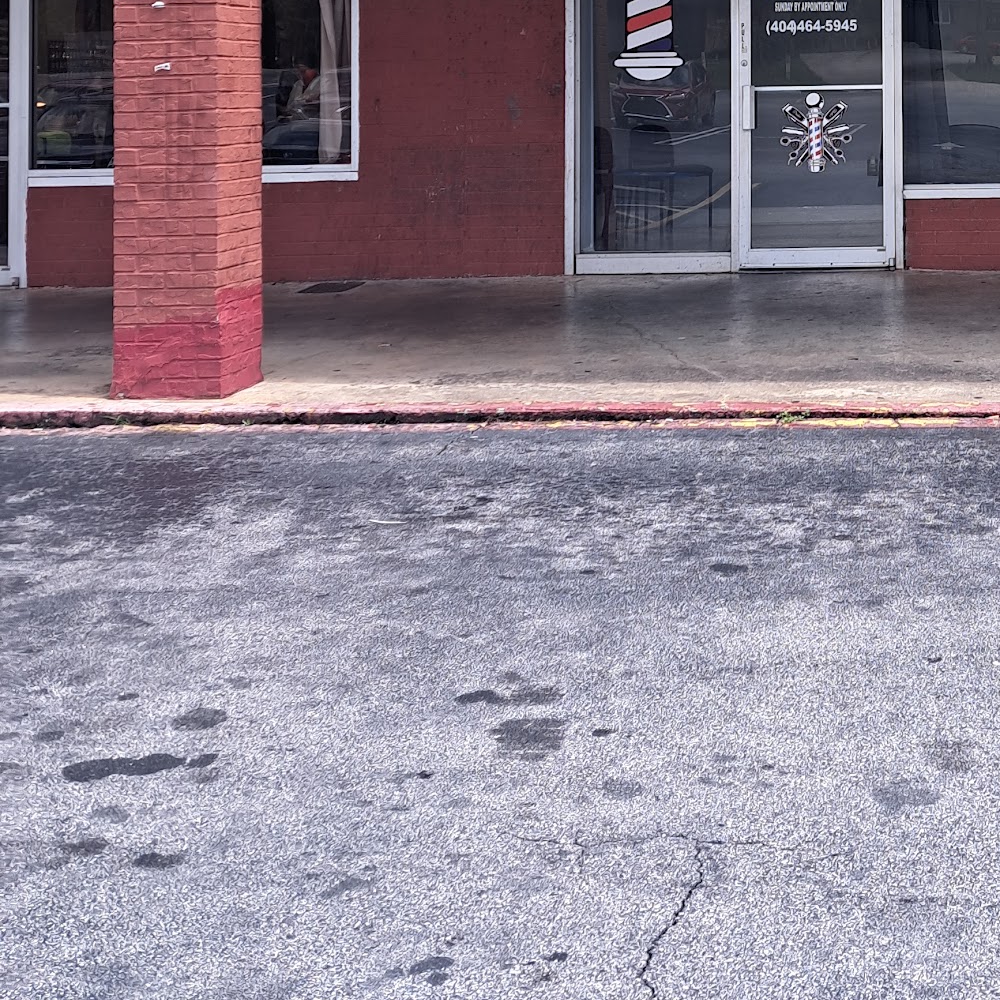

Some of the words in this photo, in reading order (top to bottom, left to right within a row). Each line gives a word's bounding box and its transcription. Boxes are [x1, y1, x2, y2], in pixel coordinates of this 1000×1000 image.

[774, 2, 793, 12] SUNDAY
[794, 2, 800, 12] BY
[801, 2, 834, 12] APPOINTMENT
[834, 2, 848, 12] ONLY
